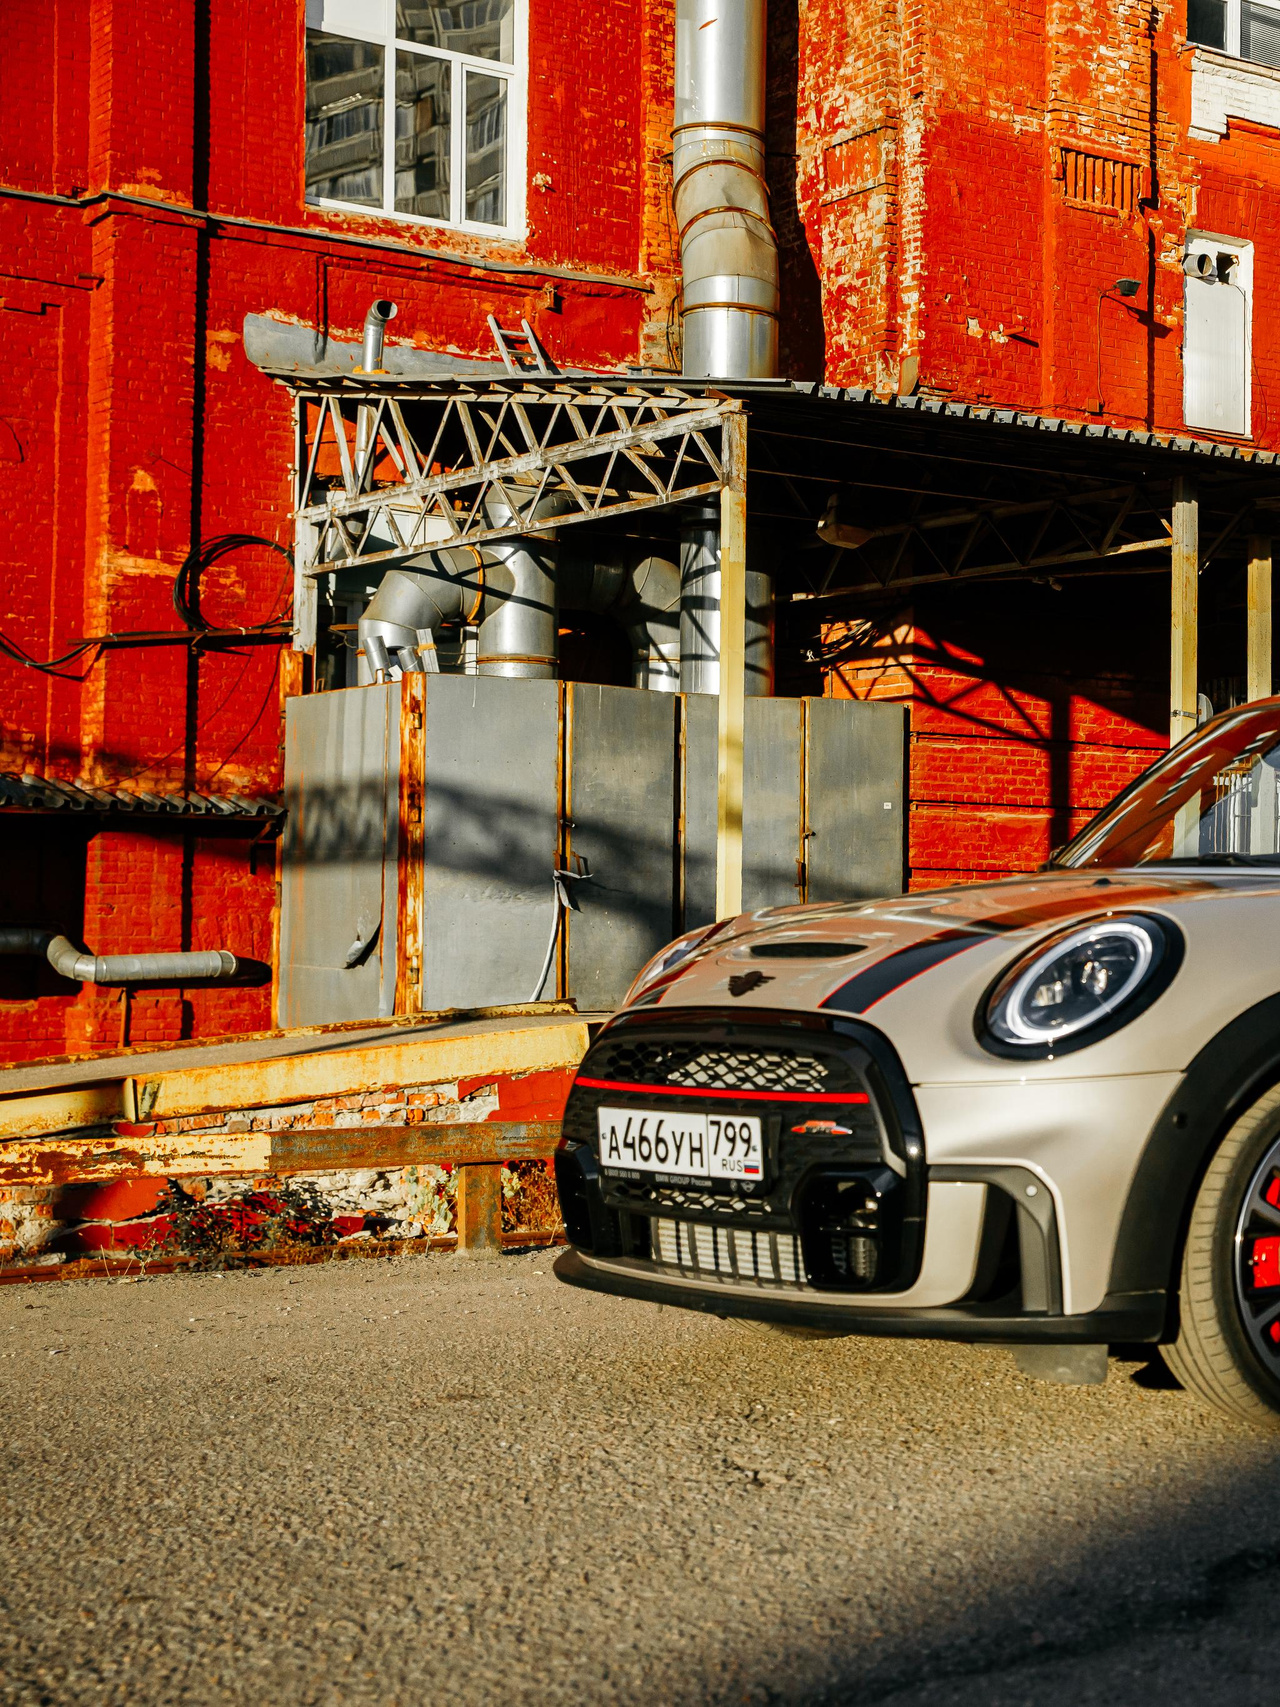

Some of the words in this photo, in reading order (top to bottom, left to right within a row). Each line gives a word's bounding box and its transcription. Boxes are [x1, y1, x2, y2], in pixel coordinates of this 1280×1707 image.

[609, 1117, 704, 1168] А466УН
[709, 1120, 752, 1158] 799
[722, 1158, 743, 1172] RUS
[670, 1175, 690, 1185] GROUP
